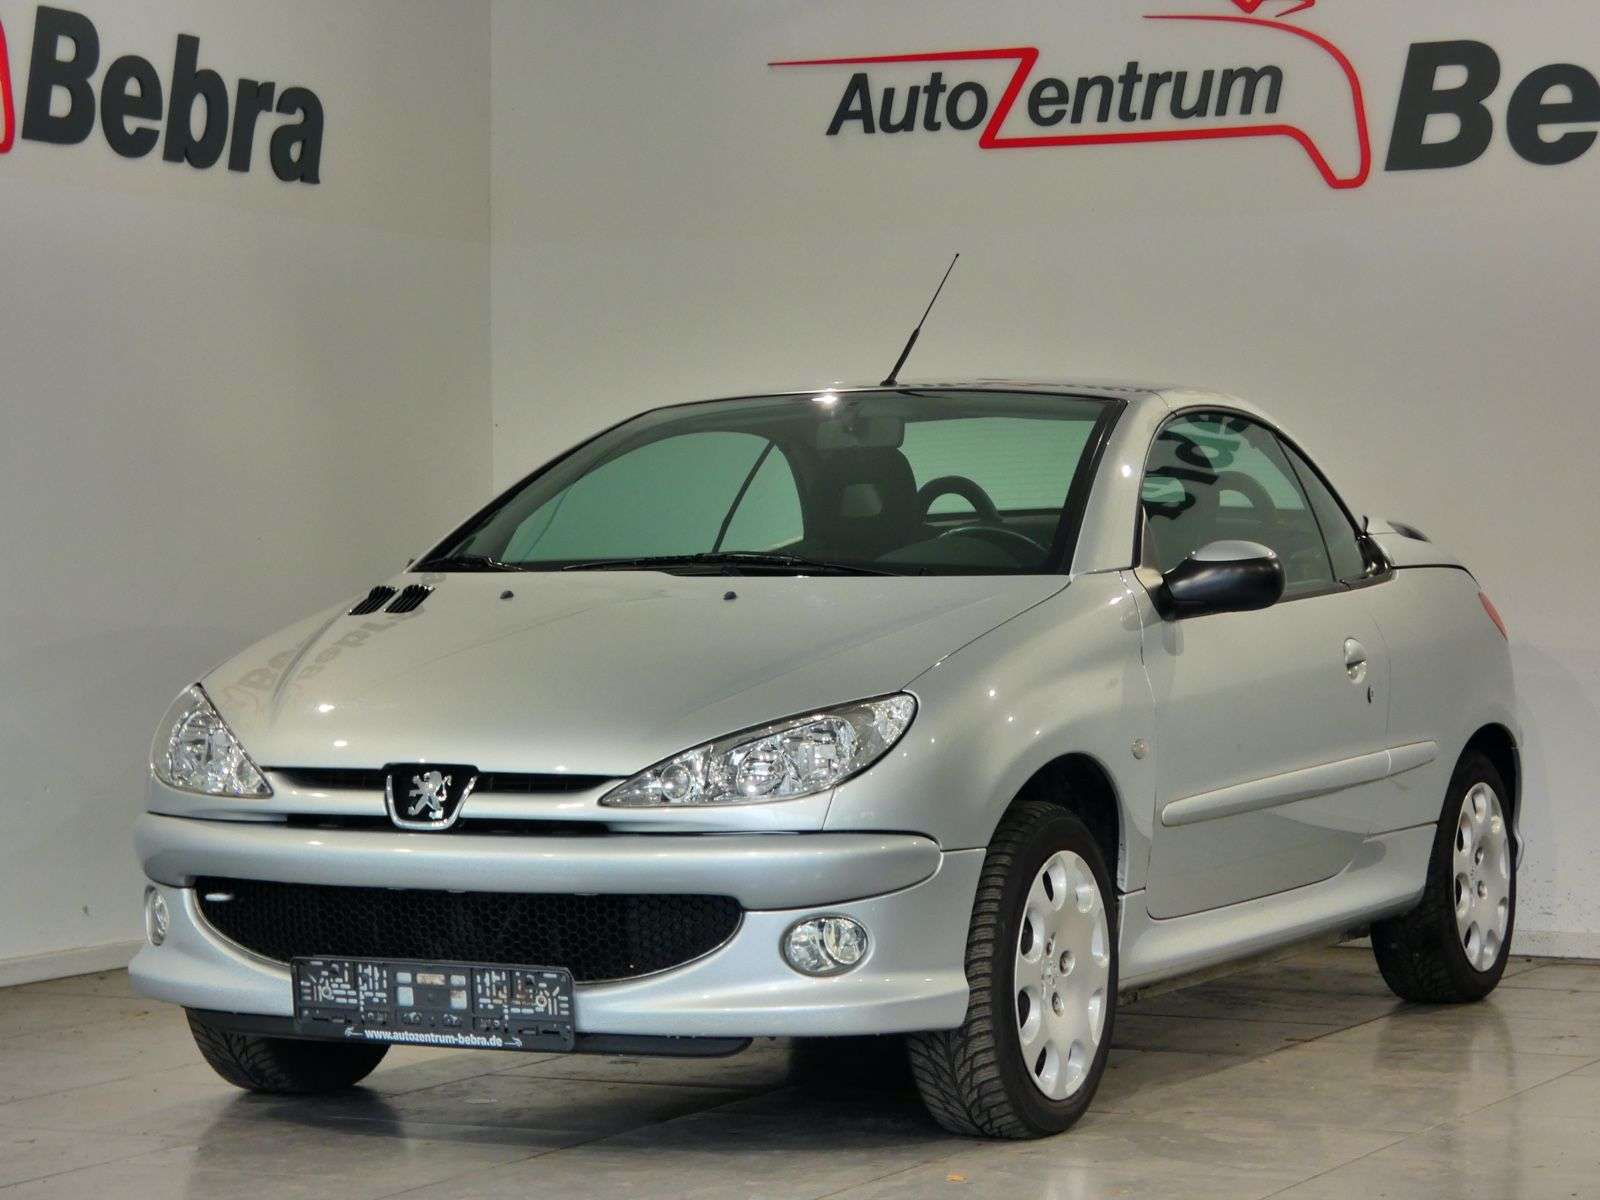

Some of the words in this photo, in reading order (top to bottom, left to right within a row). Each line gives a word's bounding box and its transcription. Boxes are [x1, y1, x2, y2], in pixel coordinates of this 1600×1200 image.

[22, 5, 324, 185] Bebra
[826, 48, 1284, 149] AutoZentrum
[364, 1029, 503, 1047] www.autozentrum-bebra.de
